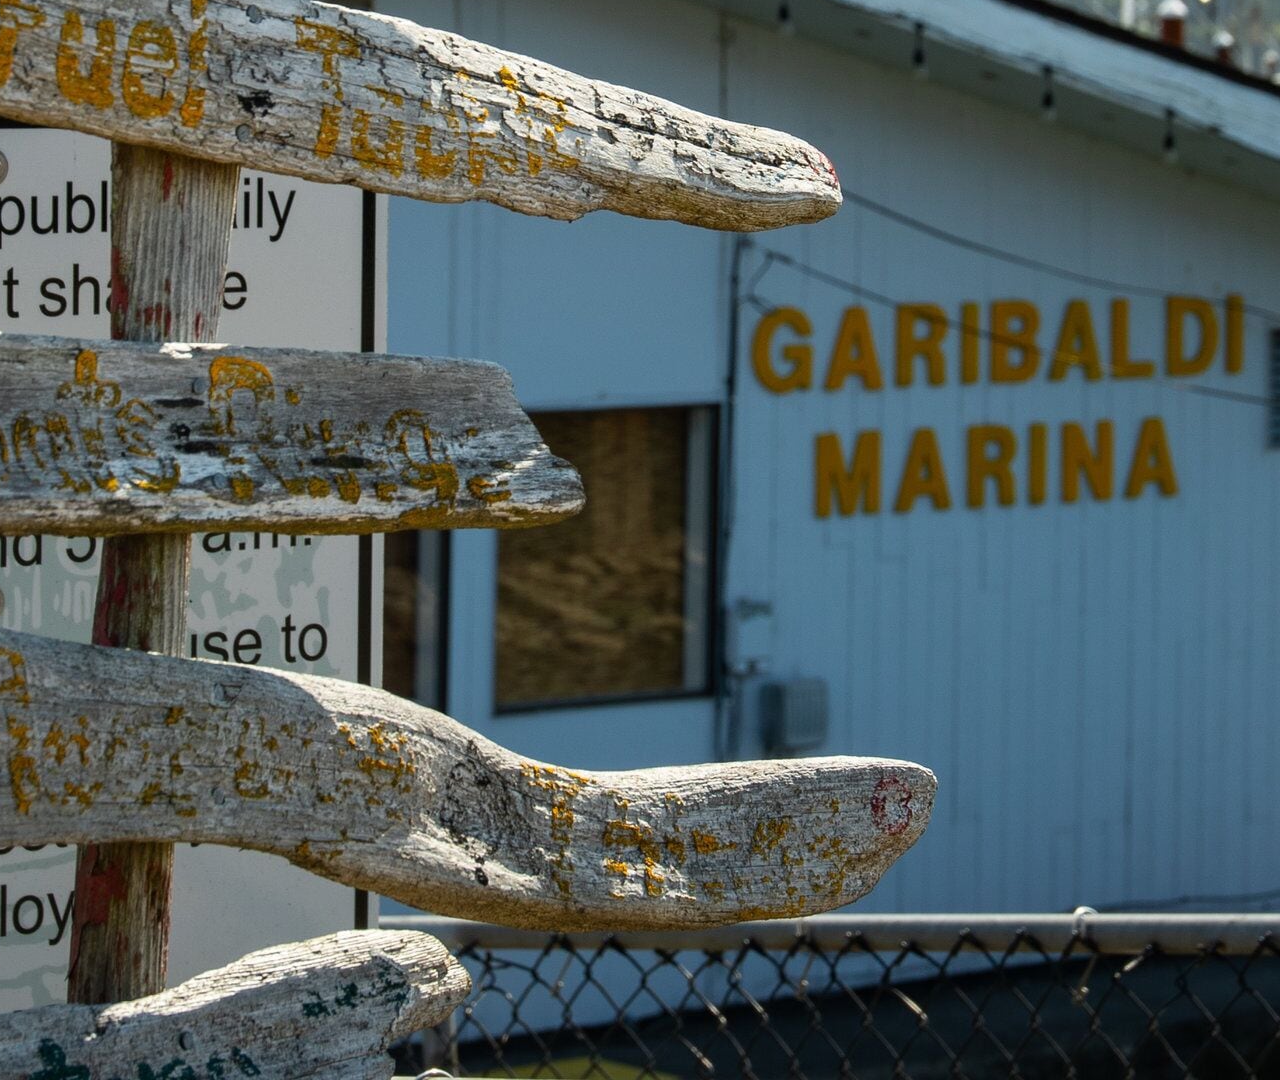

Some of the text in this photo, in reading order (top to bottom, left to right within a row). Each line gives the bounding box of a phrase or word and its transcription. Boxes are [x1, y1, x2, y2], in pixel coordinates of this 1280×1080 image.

[233, 176, 298, 243] ily
[751, 293, 1246, 395] GARIBALDI
[812, 416, 1180, 521] MARINA
[280, 614, 328, 664] to
